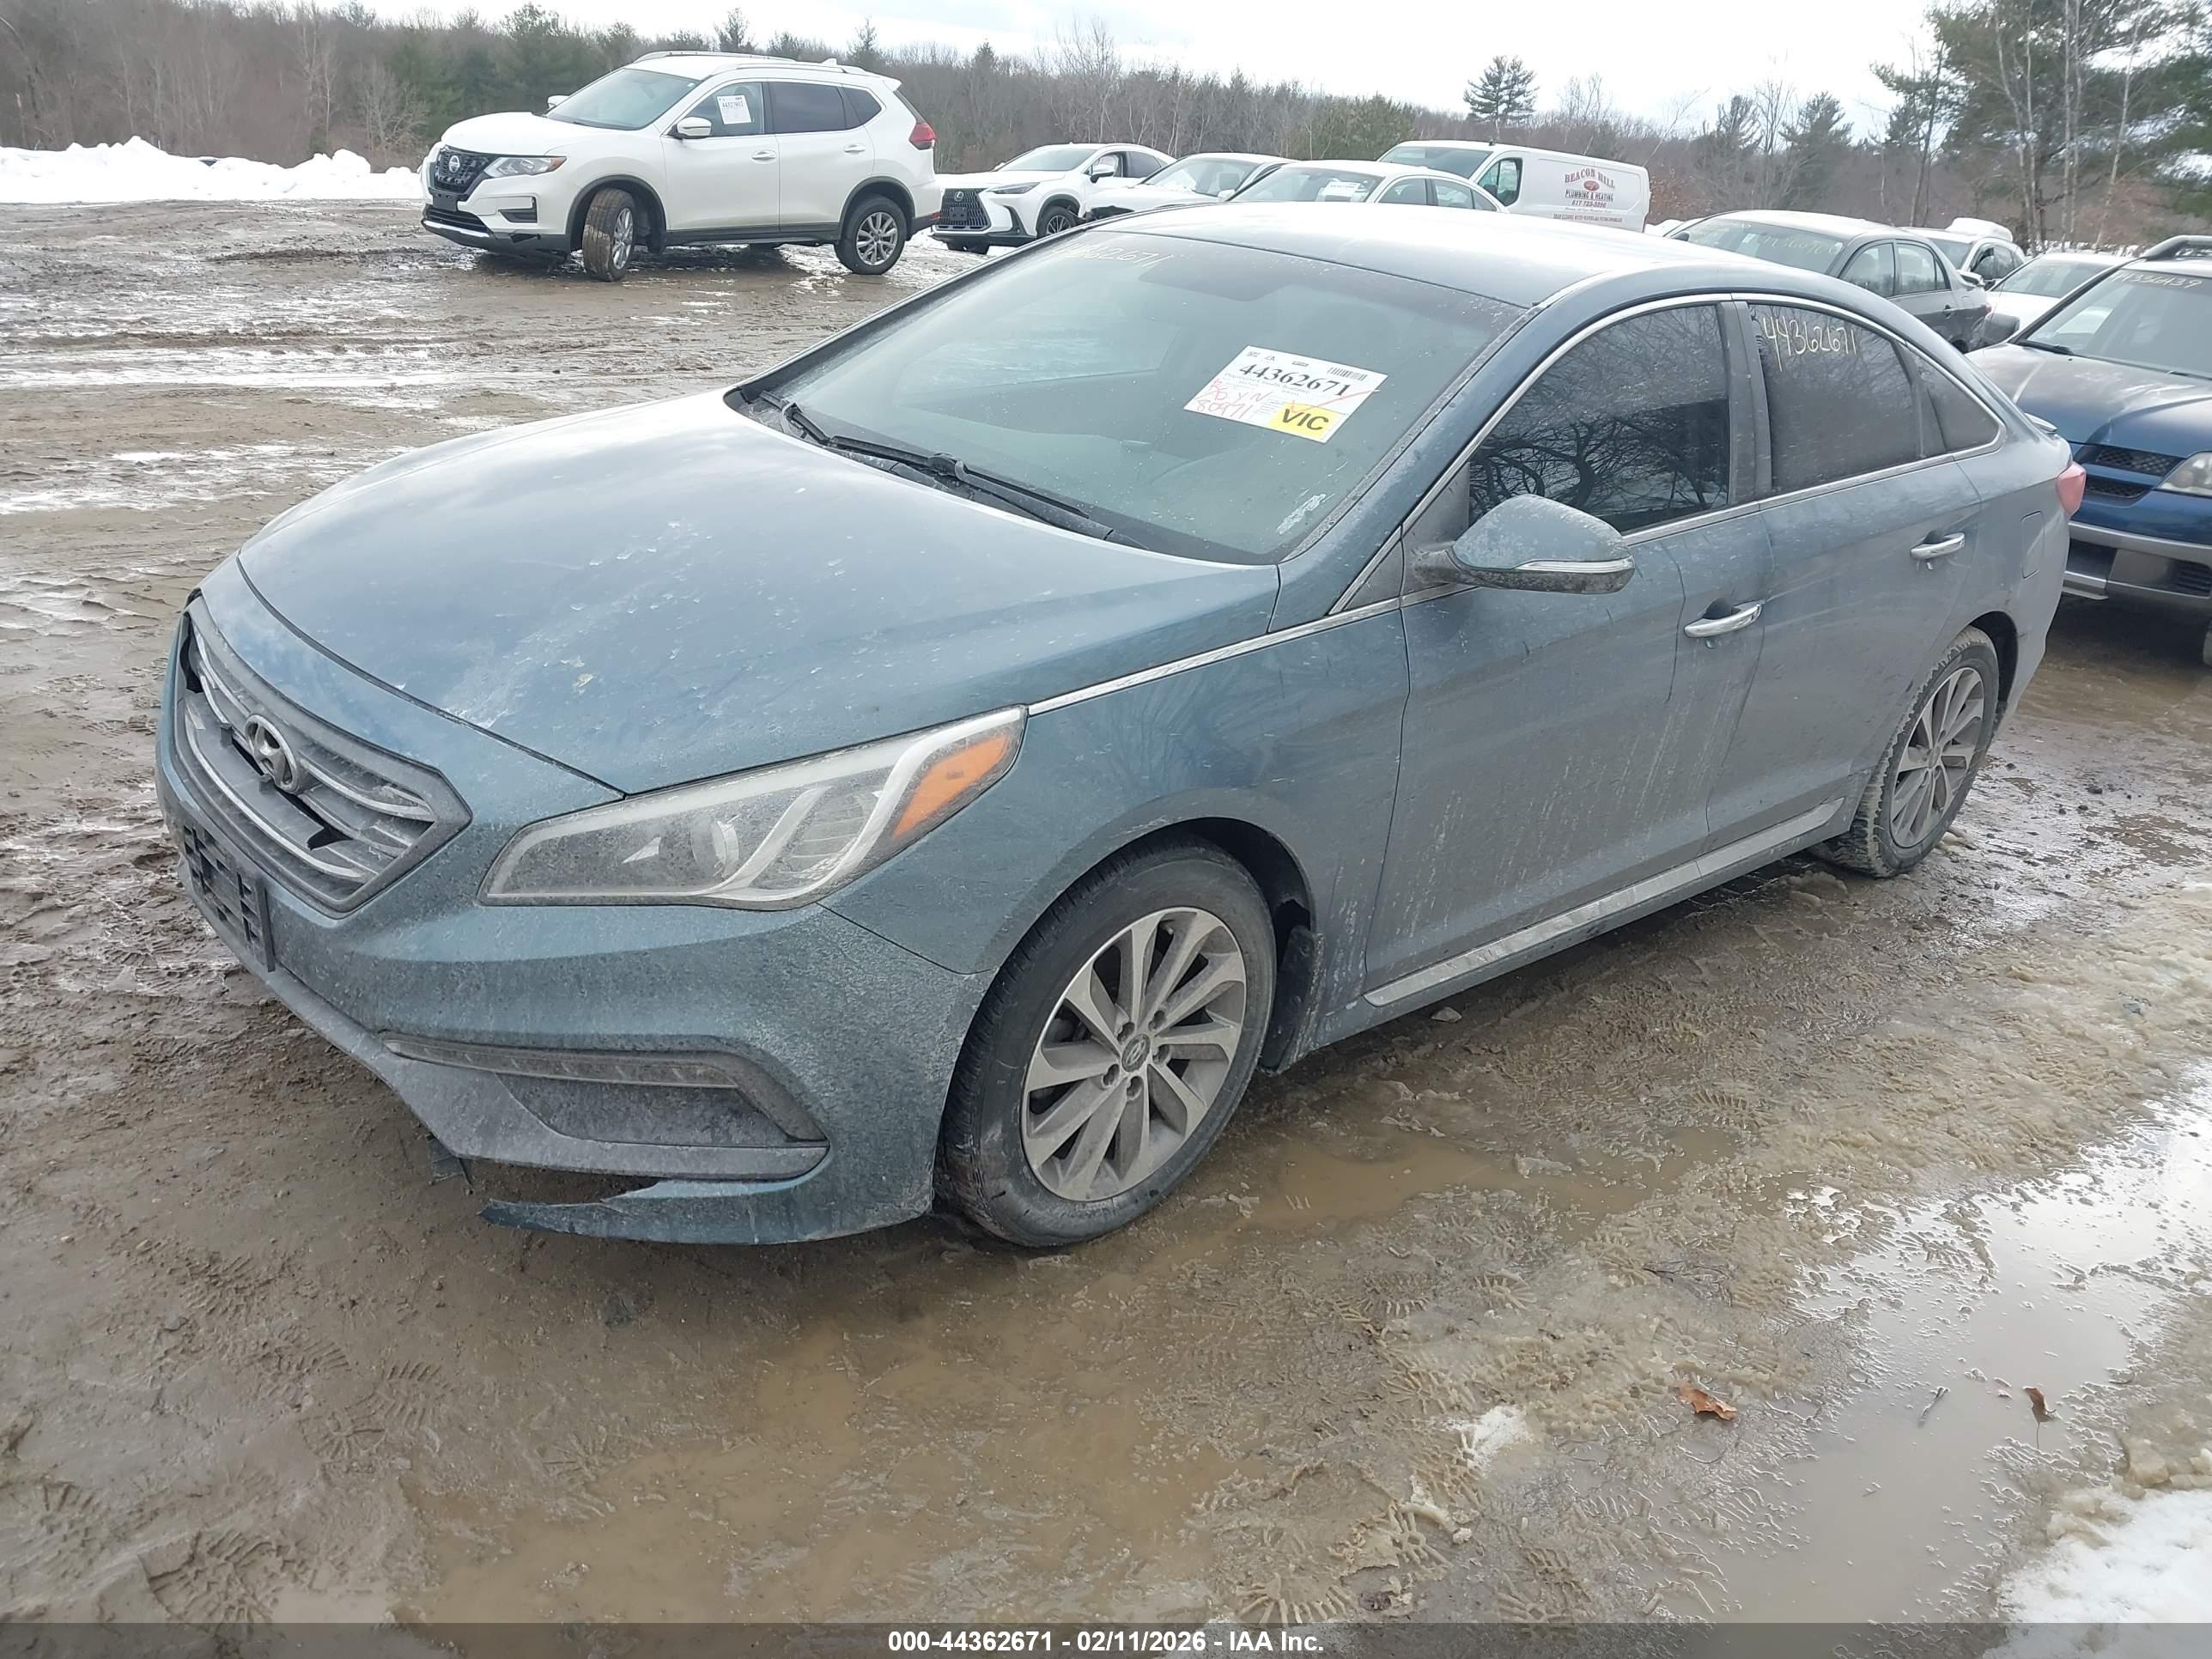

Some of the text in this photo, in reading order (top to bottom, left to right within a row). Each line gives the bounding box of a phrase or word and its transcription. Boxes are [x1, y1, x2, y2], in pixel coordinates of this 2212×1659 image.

[1565, 167, 1615, 188] BEACON HILL
[1565, 189, 1589, 200] PLUMBING
[1595, 192, 1614, 202] HEATING
[1763, 315, 1856, 372] 44362671
[1239, 363, 1352, 397] 44362671
[1282, 408, 1329, 431] VIC
